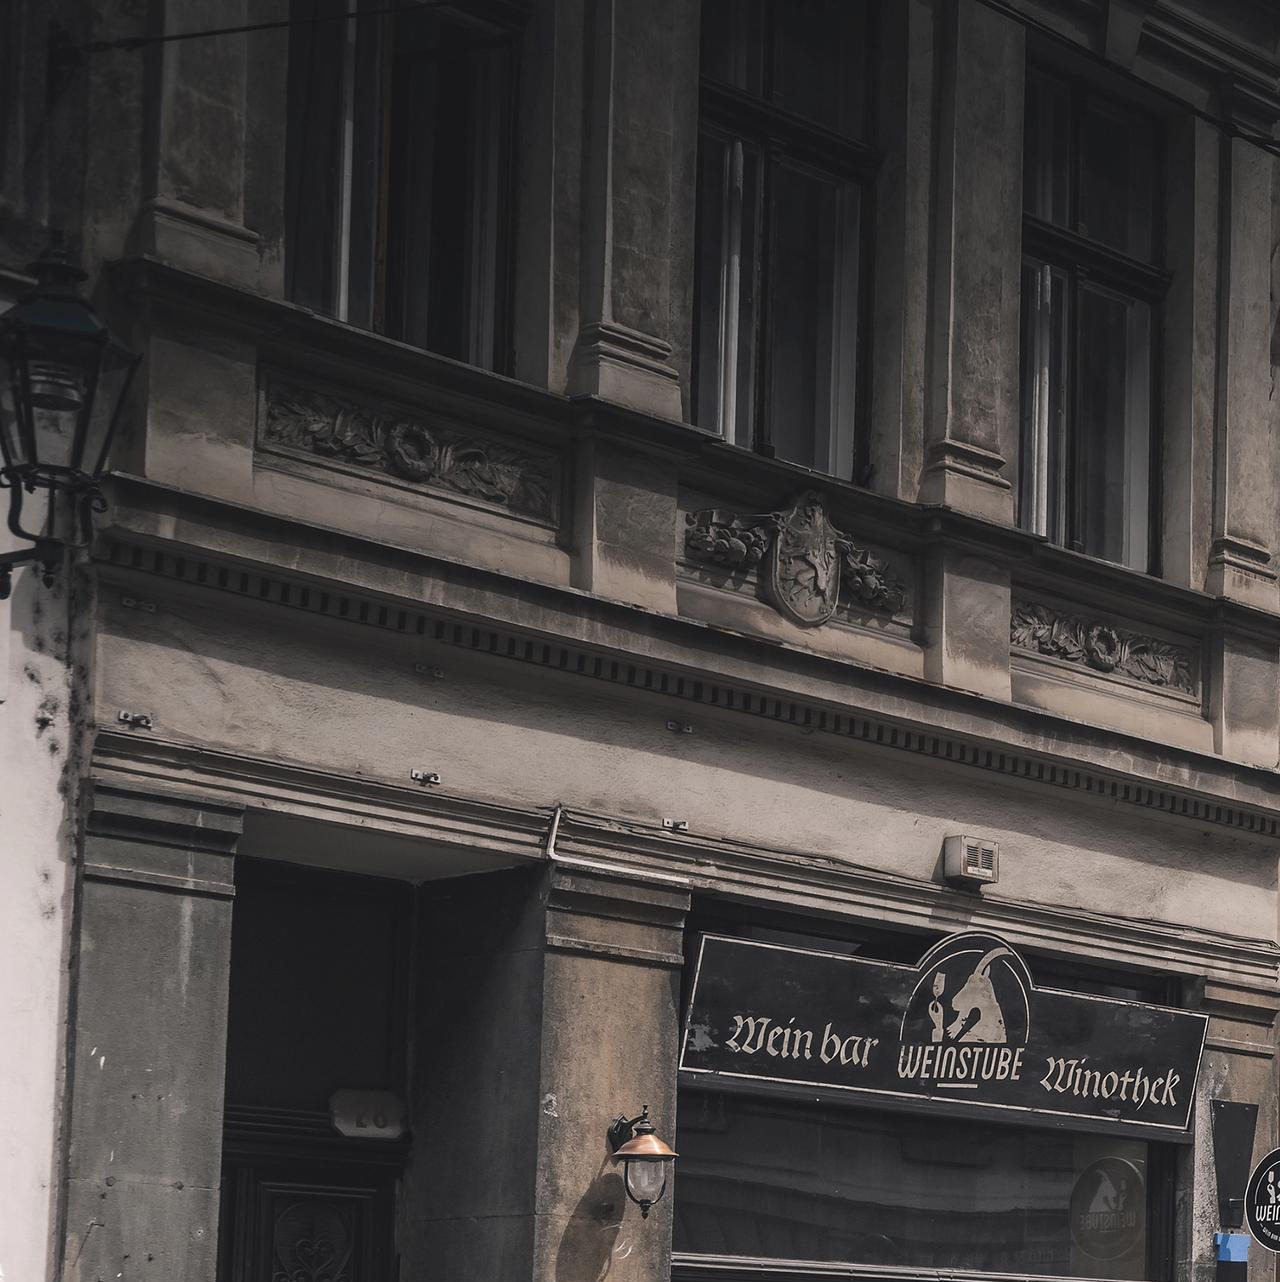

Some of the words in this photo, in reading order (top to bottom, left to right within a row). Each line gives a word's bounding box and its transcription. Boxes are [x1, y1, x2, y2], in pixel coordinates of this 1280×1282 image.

[725, 1015, 813, 1062] Wein
[818, 1021, 880, 1068] bar
[898, 1045, 1026, 1082] WEINSTUBE
[1039, 1055, 1182, 1108] Winothek
